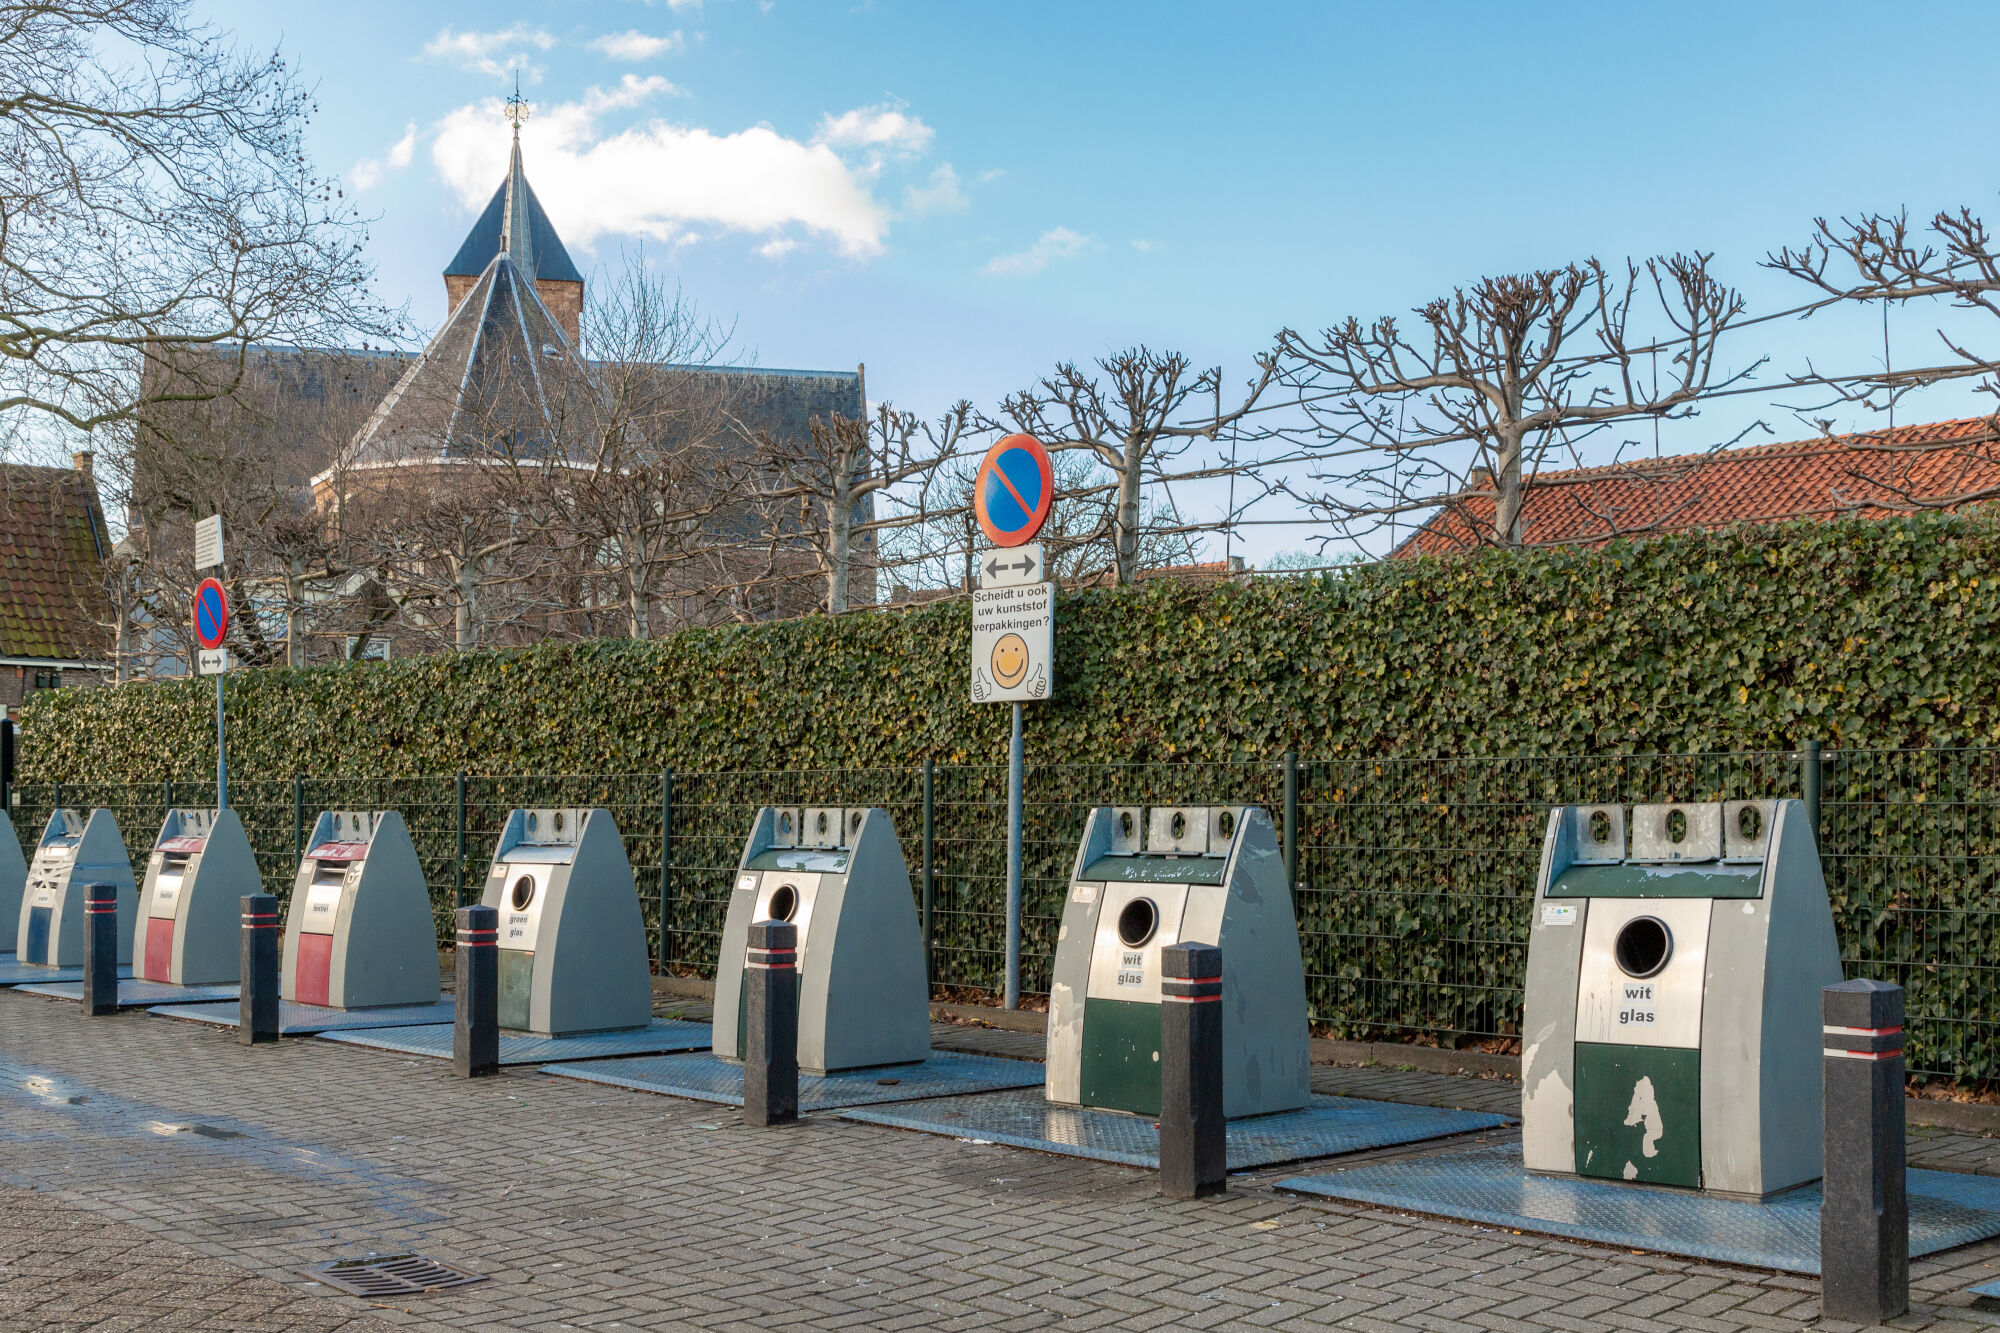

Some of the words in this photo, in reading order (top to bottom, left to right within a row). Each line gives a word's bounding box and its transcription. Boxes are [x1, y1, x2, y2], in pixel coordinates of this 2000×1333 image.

[974, 589, 1014, 603] Scheidt
[1017, 590, 1024, 598] u
[1027, 585, 1048, 597] ook
[978, 607, 993, 616] uw
[996, 599, 1047, 614] kunststof
[509, 916, 527, 924] groen
[509, 928, 523, 937] glas
[1123, 954, 1142, 966] wit
[1117, 972, 1142, 986] glas
[1625, 986, 1652, 999] wit
[1619, 1008, 1655, 1024] glas
